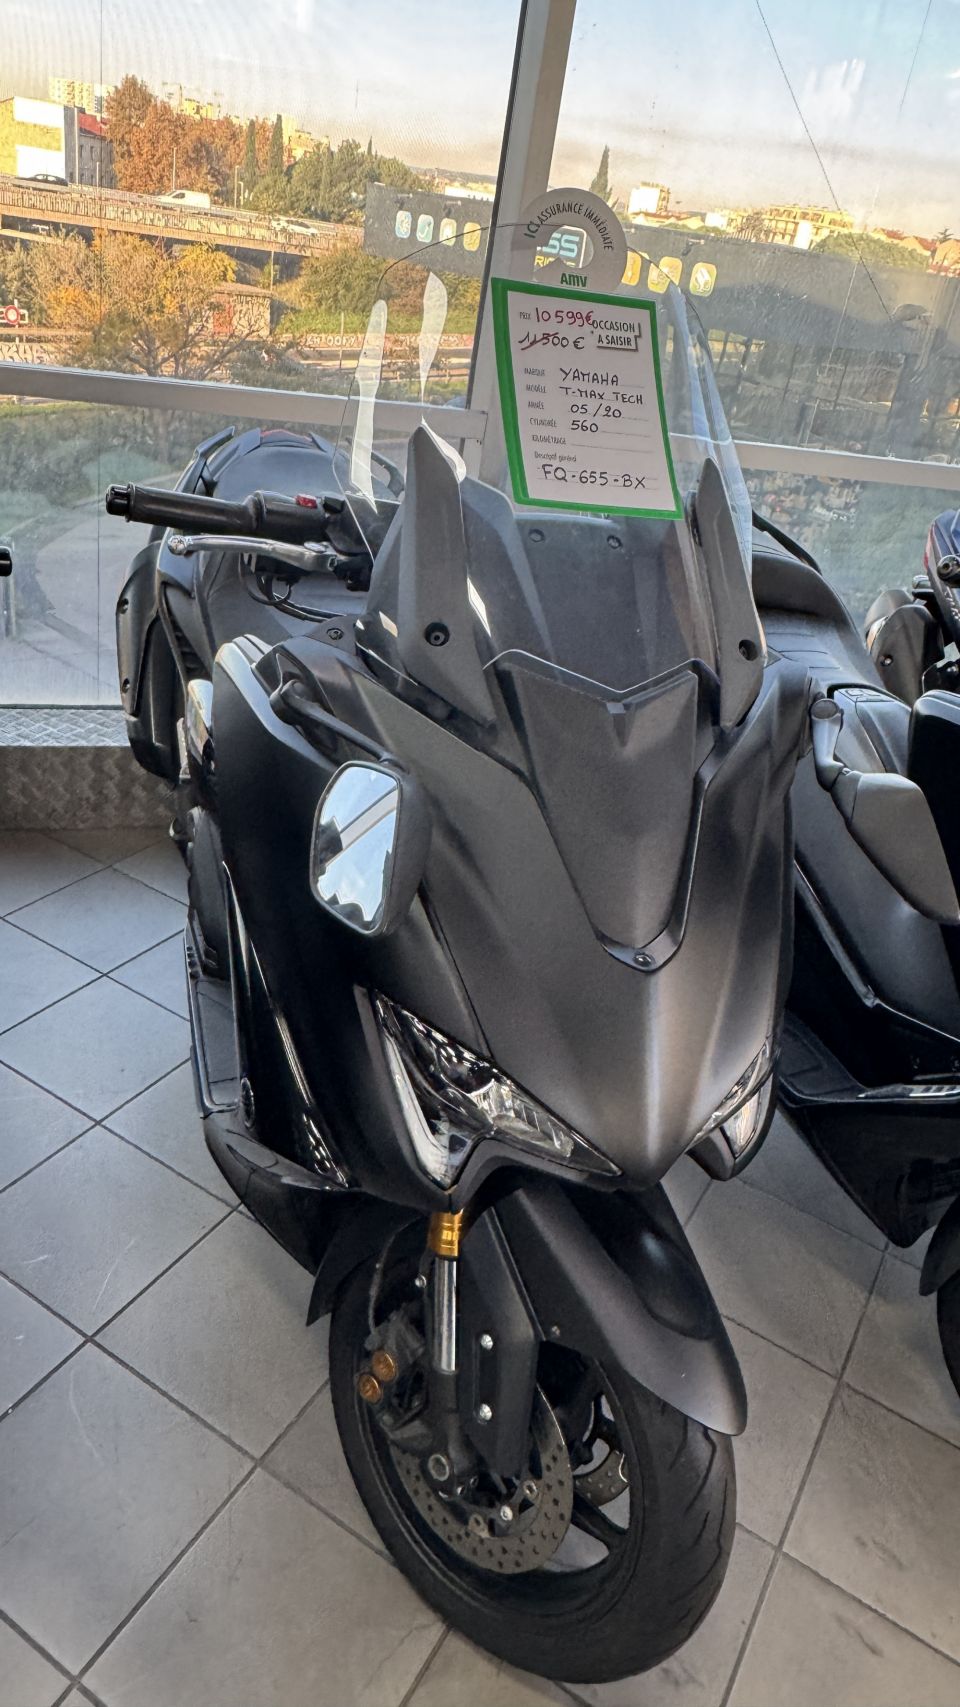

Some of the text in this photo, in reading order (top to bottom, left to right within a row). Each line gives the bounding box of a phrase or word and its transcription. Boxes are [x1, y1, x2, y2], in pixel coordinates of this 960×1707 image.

[540, 201, 584, 225] ASSURANCE
[583, 207, 615, 252] IMMÉDIATE
[592, 319, 635, 333] OCCASION
[605, 334, 633, 347] SAISIR
[559, 367, 619, 387] YAMAHA
[612, 391, 643, 405] TECH
[570, 419, 599, 433] 560
